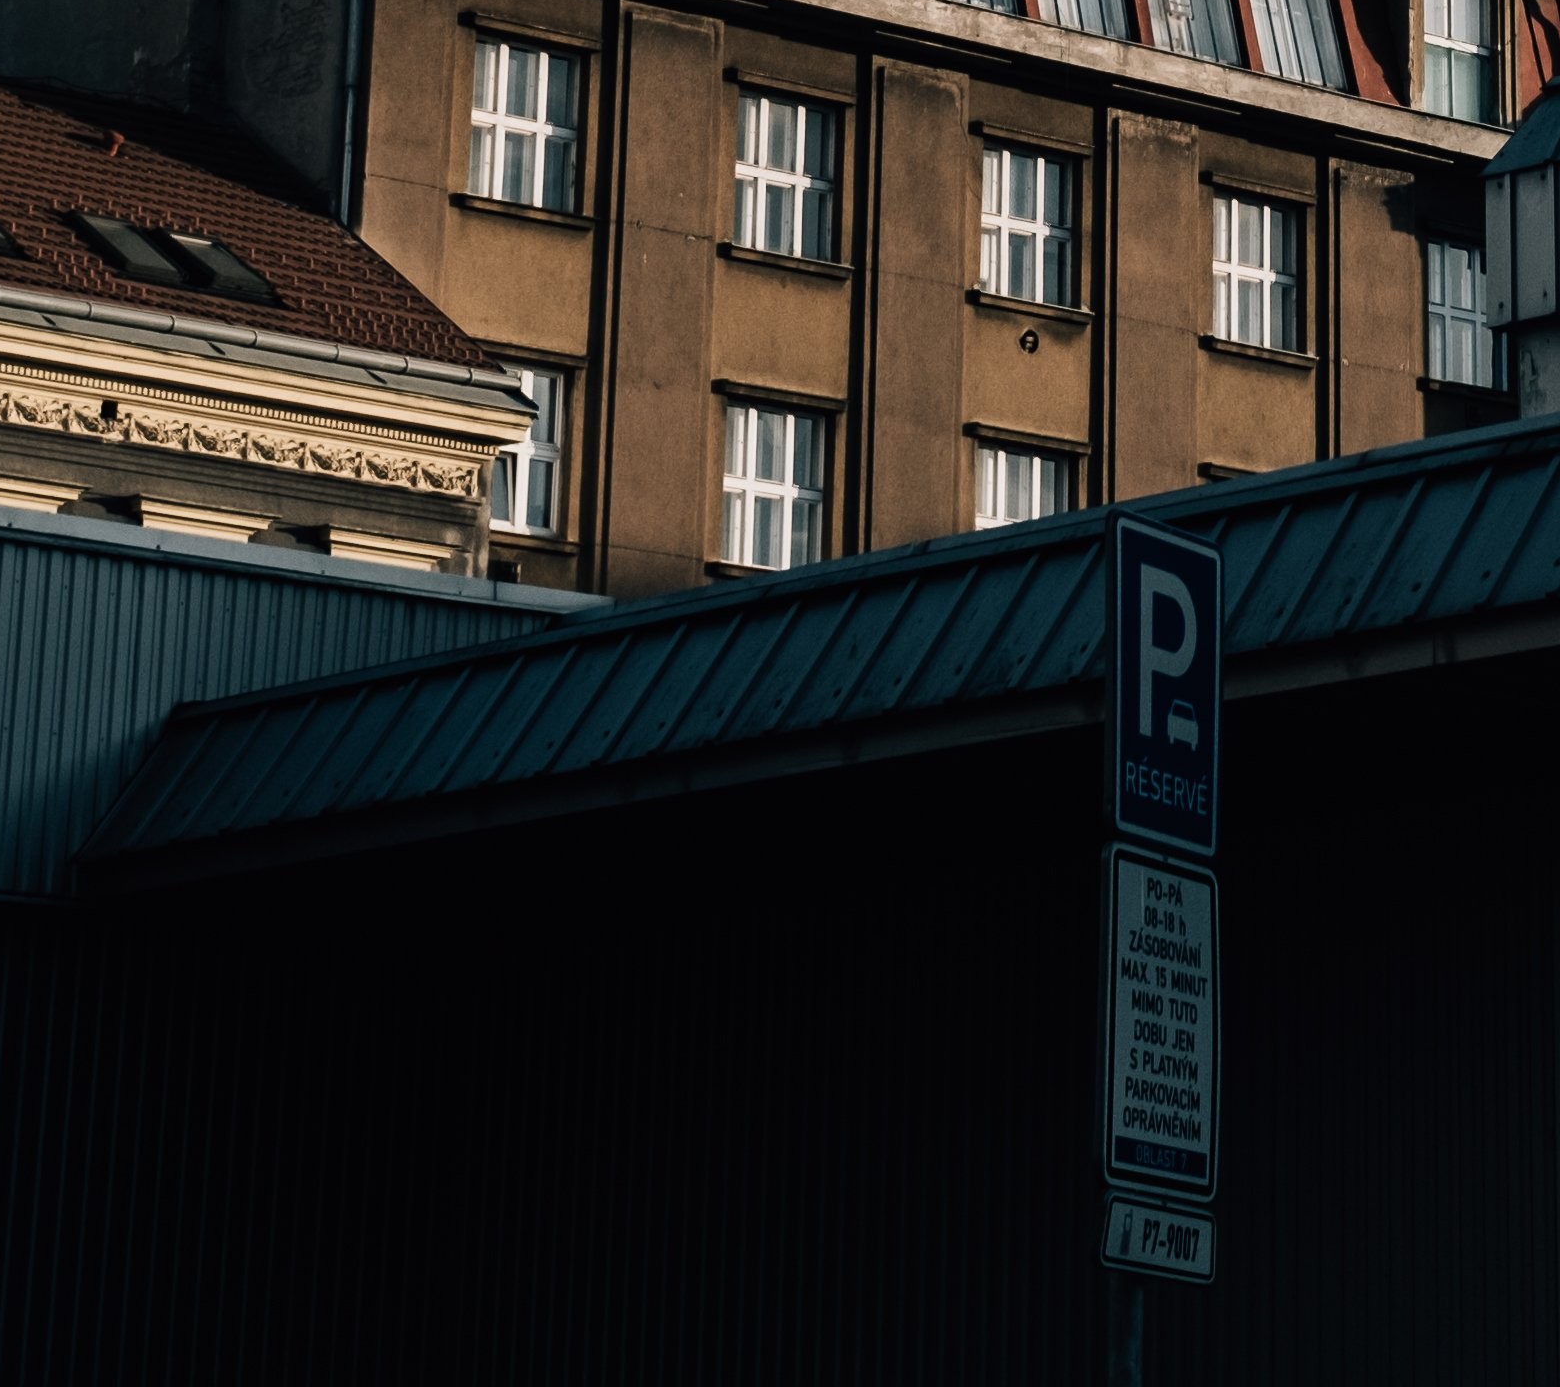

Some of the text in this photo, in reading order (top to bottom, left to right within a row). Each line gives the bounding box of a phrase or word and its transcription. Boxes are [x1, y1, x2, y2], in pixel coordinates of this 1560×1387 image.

[1140, 562, 1197, 738] P
[1125, 756, 1209, 816] RÉSERVÉ
[1147, 877, 1183, 907] PO-PÁ
[1144, 905, 1186, 937] 08-18 h
[1129, 928, 1202, 969] ZÁSOBOVÁNÍ
[1121, 957, 1208, 998] MAX. 15 MINUT
[1131, 989, 1198, 1025] MIMO TUTO
[1134, 1019, 1195, 1054] DOBU JEN
[1129, 1047, 1198, 1085] S PLATNÝM
[1125, 1076, 1201, 1114] PARKOVACÍM
[1122, 1105, 1201, 1143] OPRÁVNĚNÍM
[1135, 1143, 1188, 1172] OBLAST 7
[1142, 1218, 1200, 1262] P7-9007
